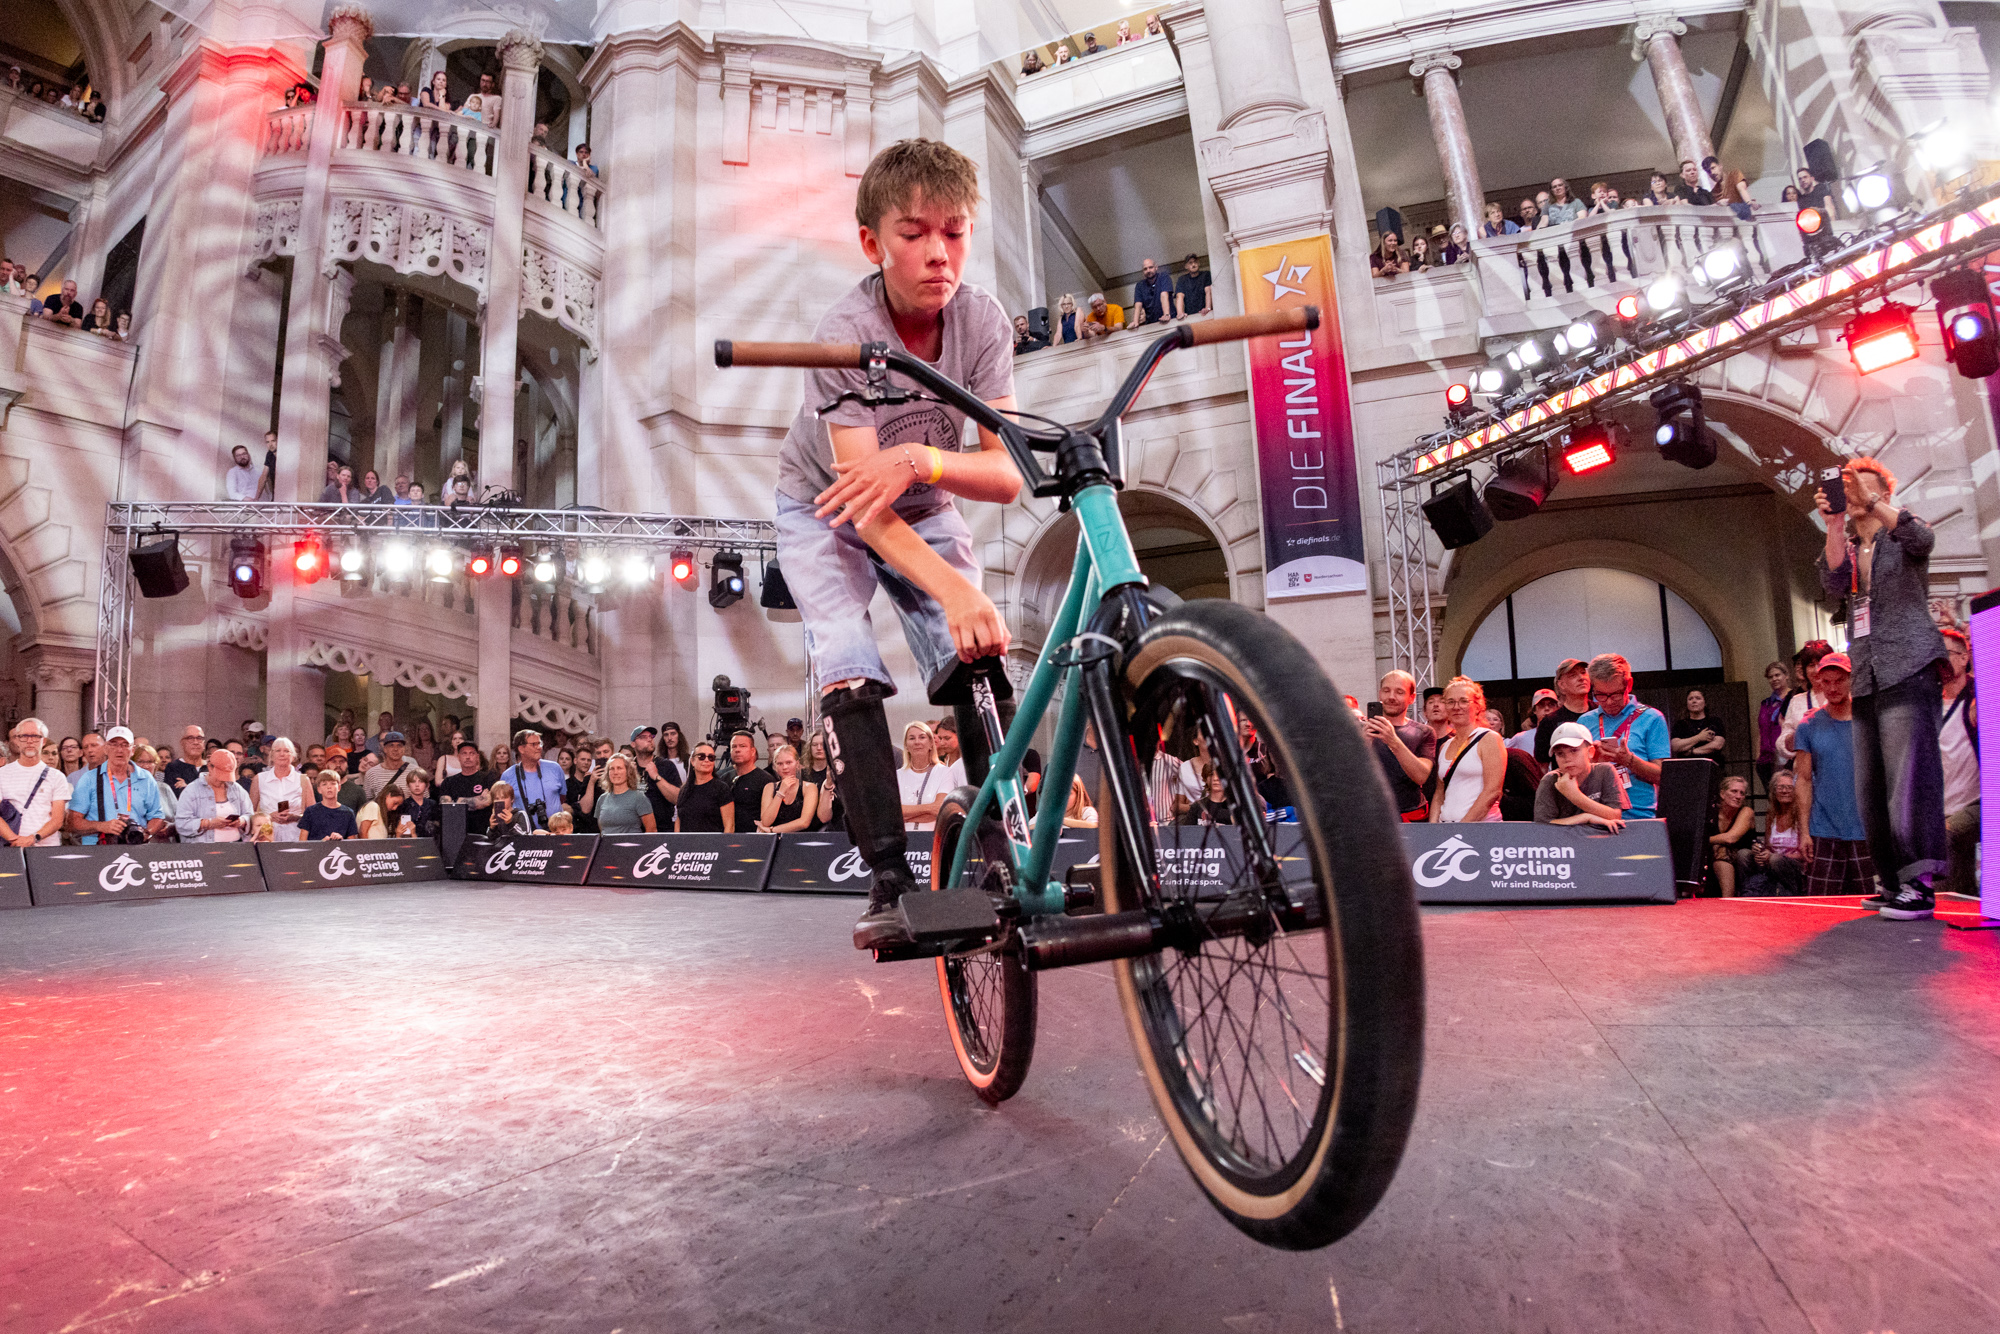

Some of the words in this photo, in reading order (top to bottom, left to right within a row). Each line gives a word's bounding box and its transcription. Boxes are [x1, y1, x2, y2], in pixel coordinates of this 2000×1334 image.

[1274, 307, 1324, 438] FINAL
[1290, 450, 1328, 509] DIE
[356, 852, 399, 864] german
[518, 849, 553, 860] german
[674, 852, 719, 863] german
[1489, 846, 1576, 863] german
[148, 859, 204, 873] german
[359, 861, 400, 873] cycling
[515, 858, 548, 870] cycling
[671, 861, 713, 874] cycling
[1490, 860, 1571, 880] cycling
[151, 869, 203, 884] cycling
[1491, 880, 1508, 888] Wir
[1509, 880, 1530, 888] sind
[1531, 880, 1578, 890] Radsport.
